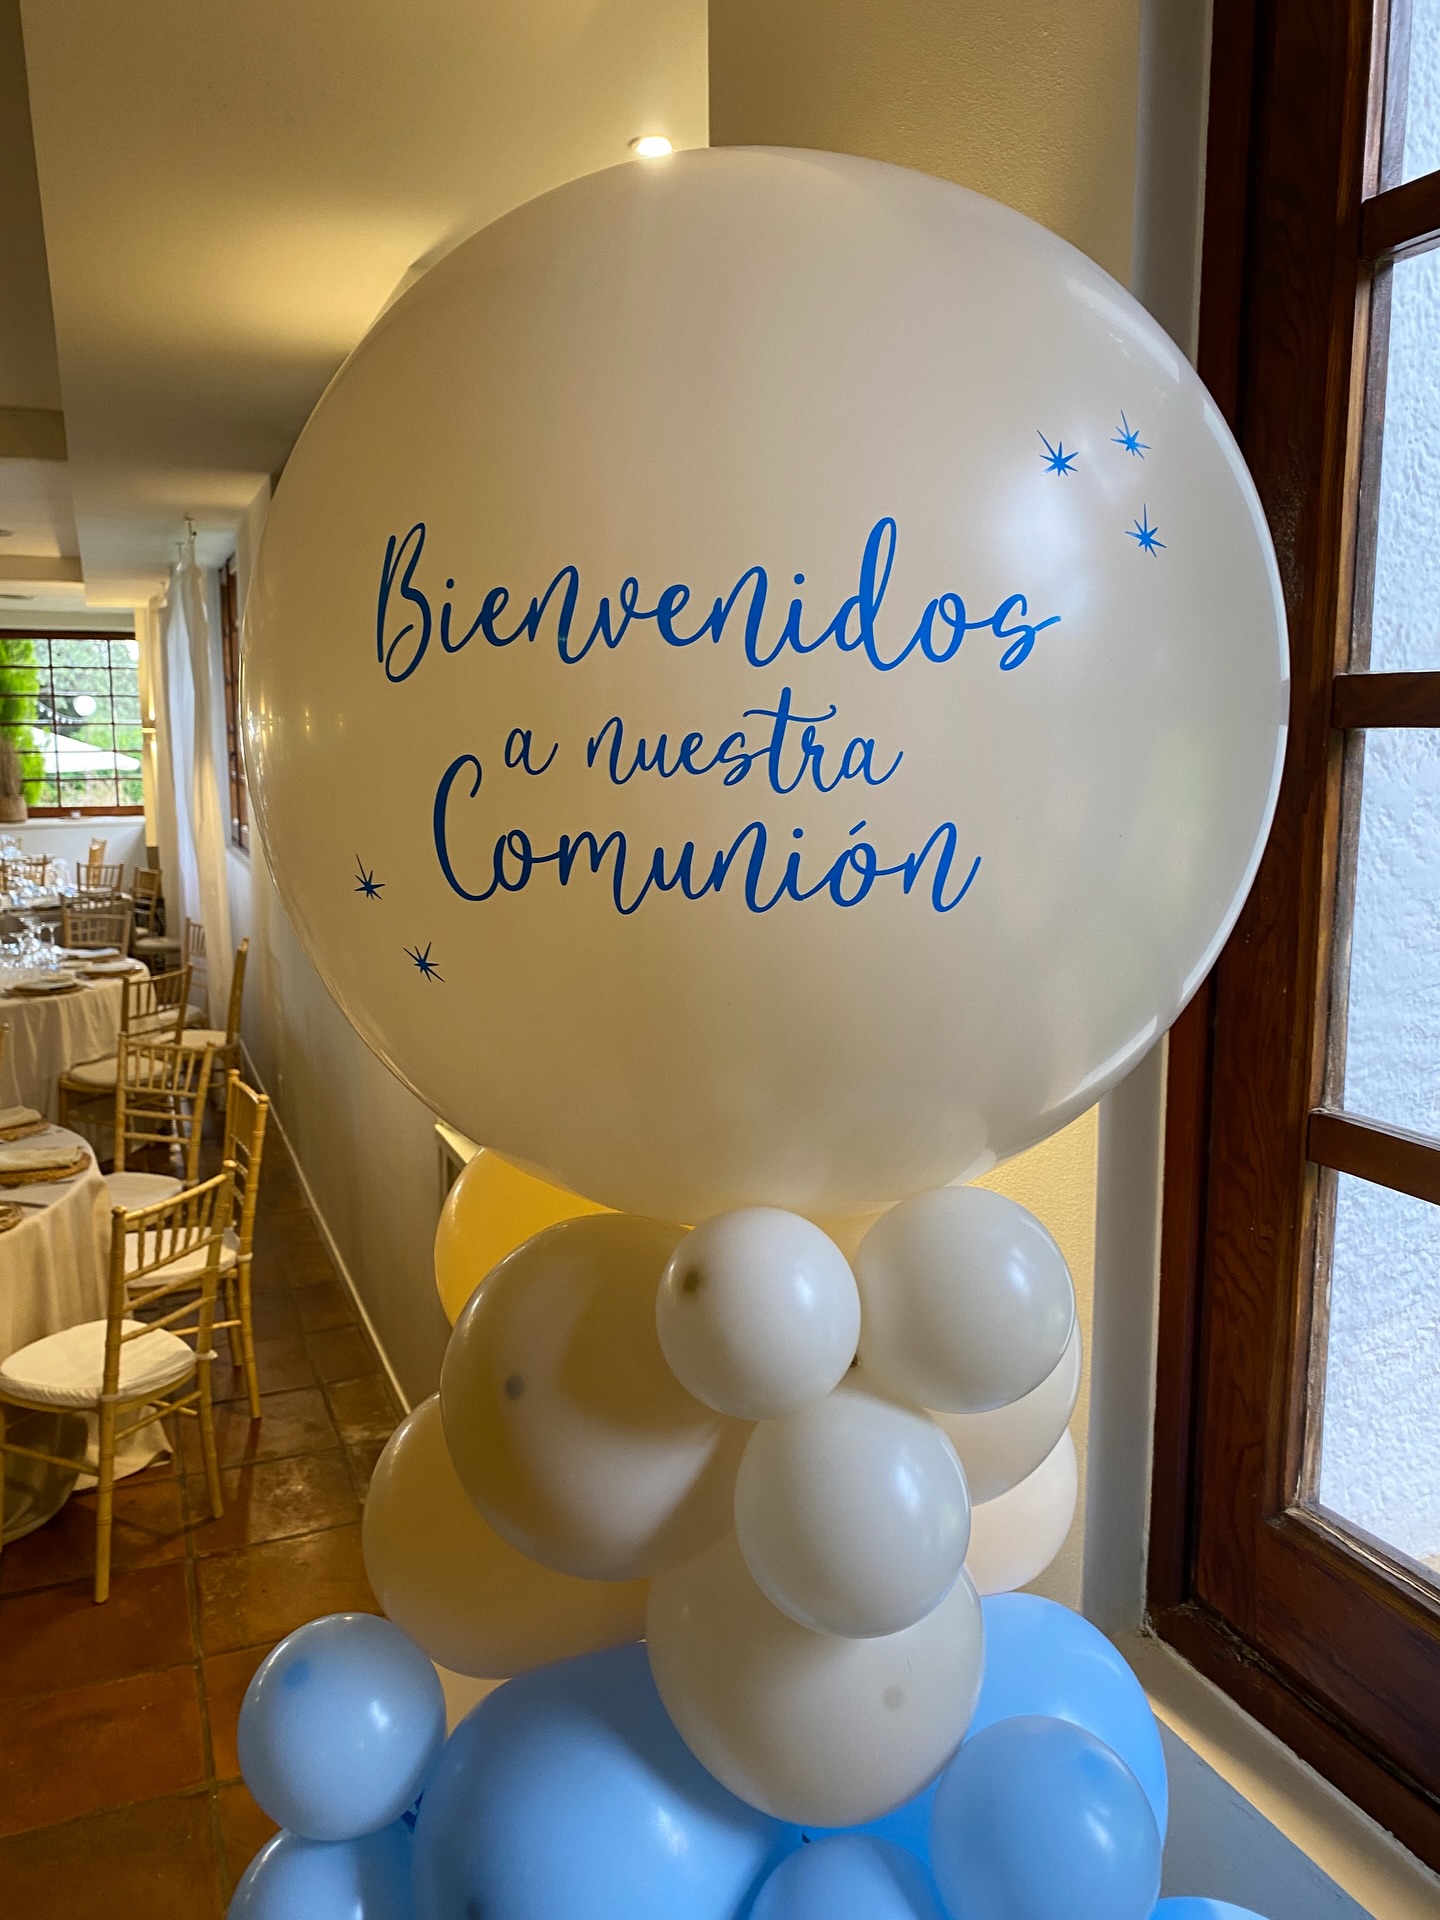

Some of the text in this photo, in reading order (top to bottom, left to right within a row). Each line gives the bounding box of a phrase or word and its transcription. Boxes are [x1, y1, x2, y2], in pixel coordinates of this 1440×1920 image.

[376, 516, 1062, 683] Bienvenidos
[504, 686, 904, 794] a nuestra
[433, 754, 982, 915] Comunión
